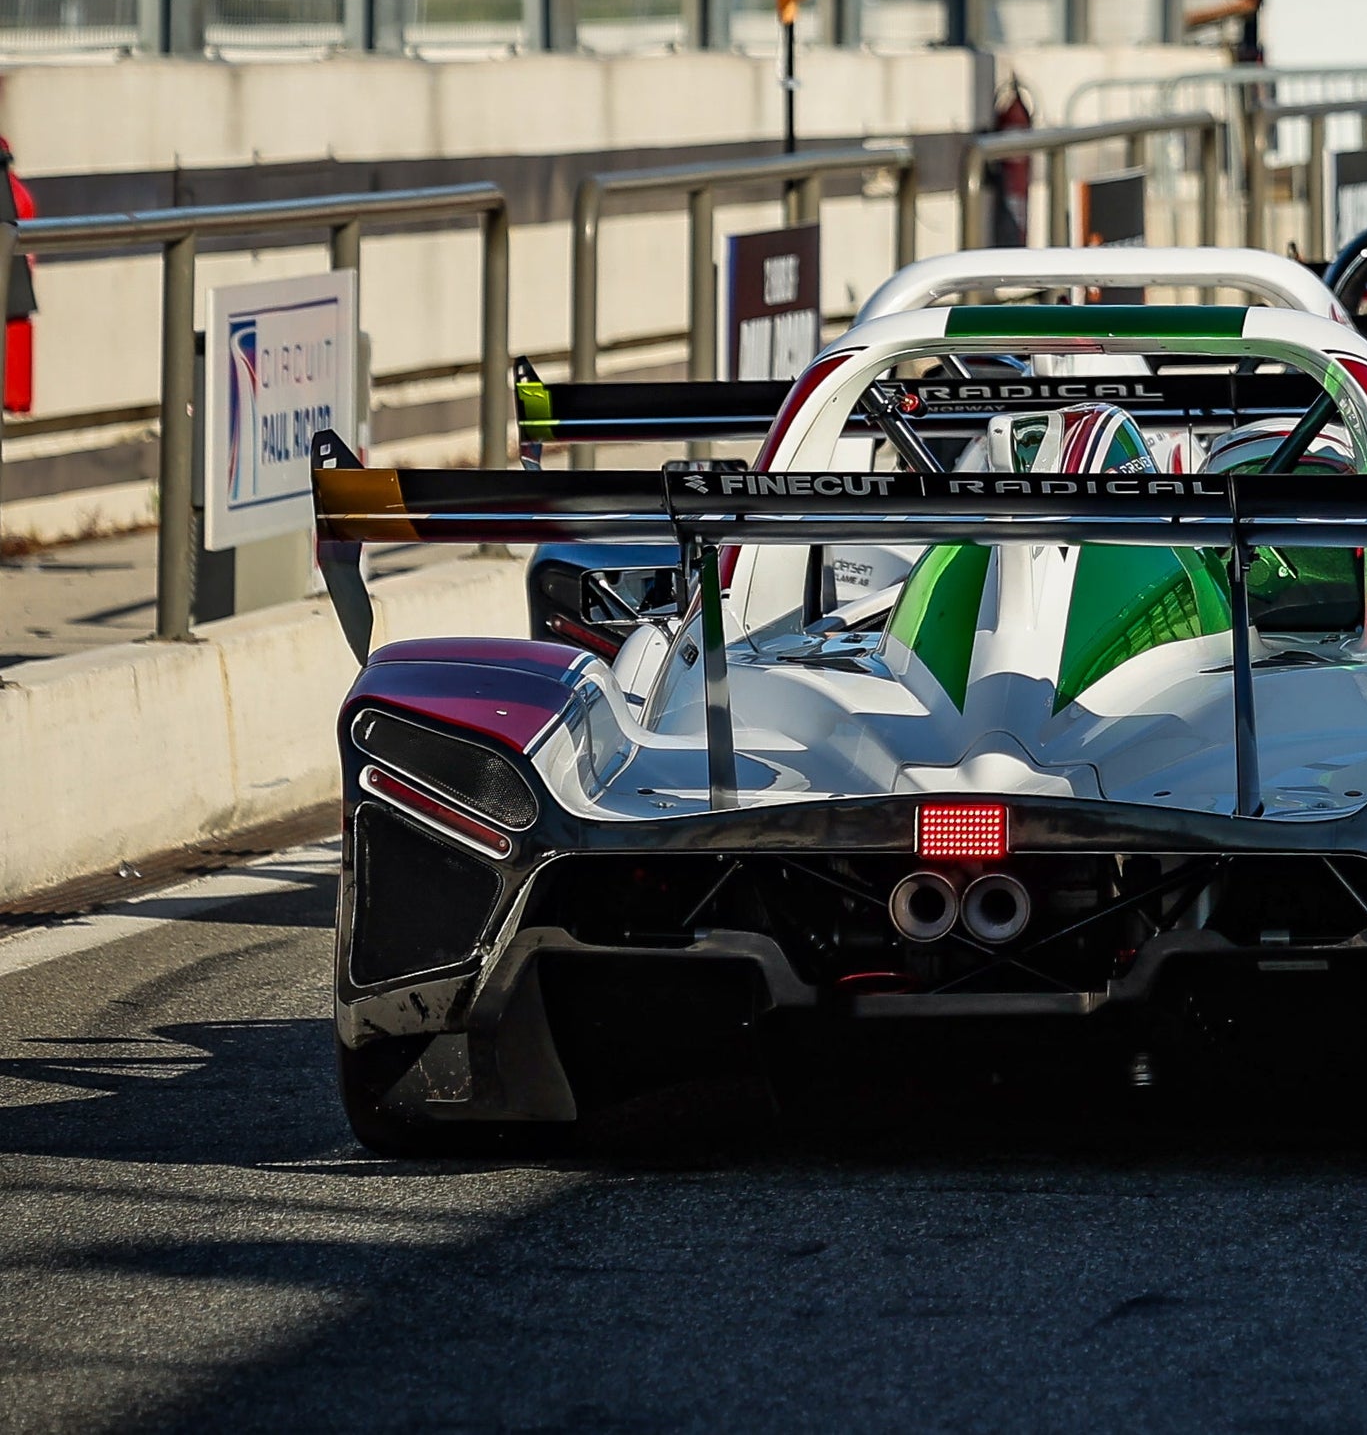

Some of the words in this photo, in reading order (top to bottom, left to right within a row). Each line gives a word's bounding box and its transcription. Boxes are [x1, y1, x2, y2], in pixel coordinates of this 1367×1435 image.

[261, 338, 332, 389] CIRCUIT
[918, 383, 1164, 400] RADICAL
[927, 404, 1006, 414] NORWAY
[261, 412, 290, 465] PAUL
[720, 475, 895, 496] FINECUT
[949, 480, 1224, 495] RADICAL
